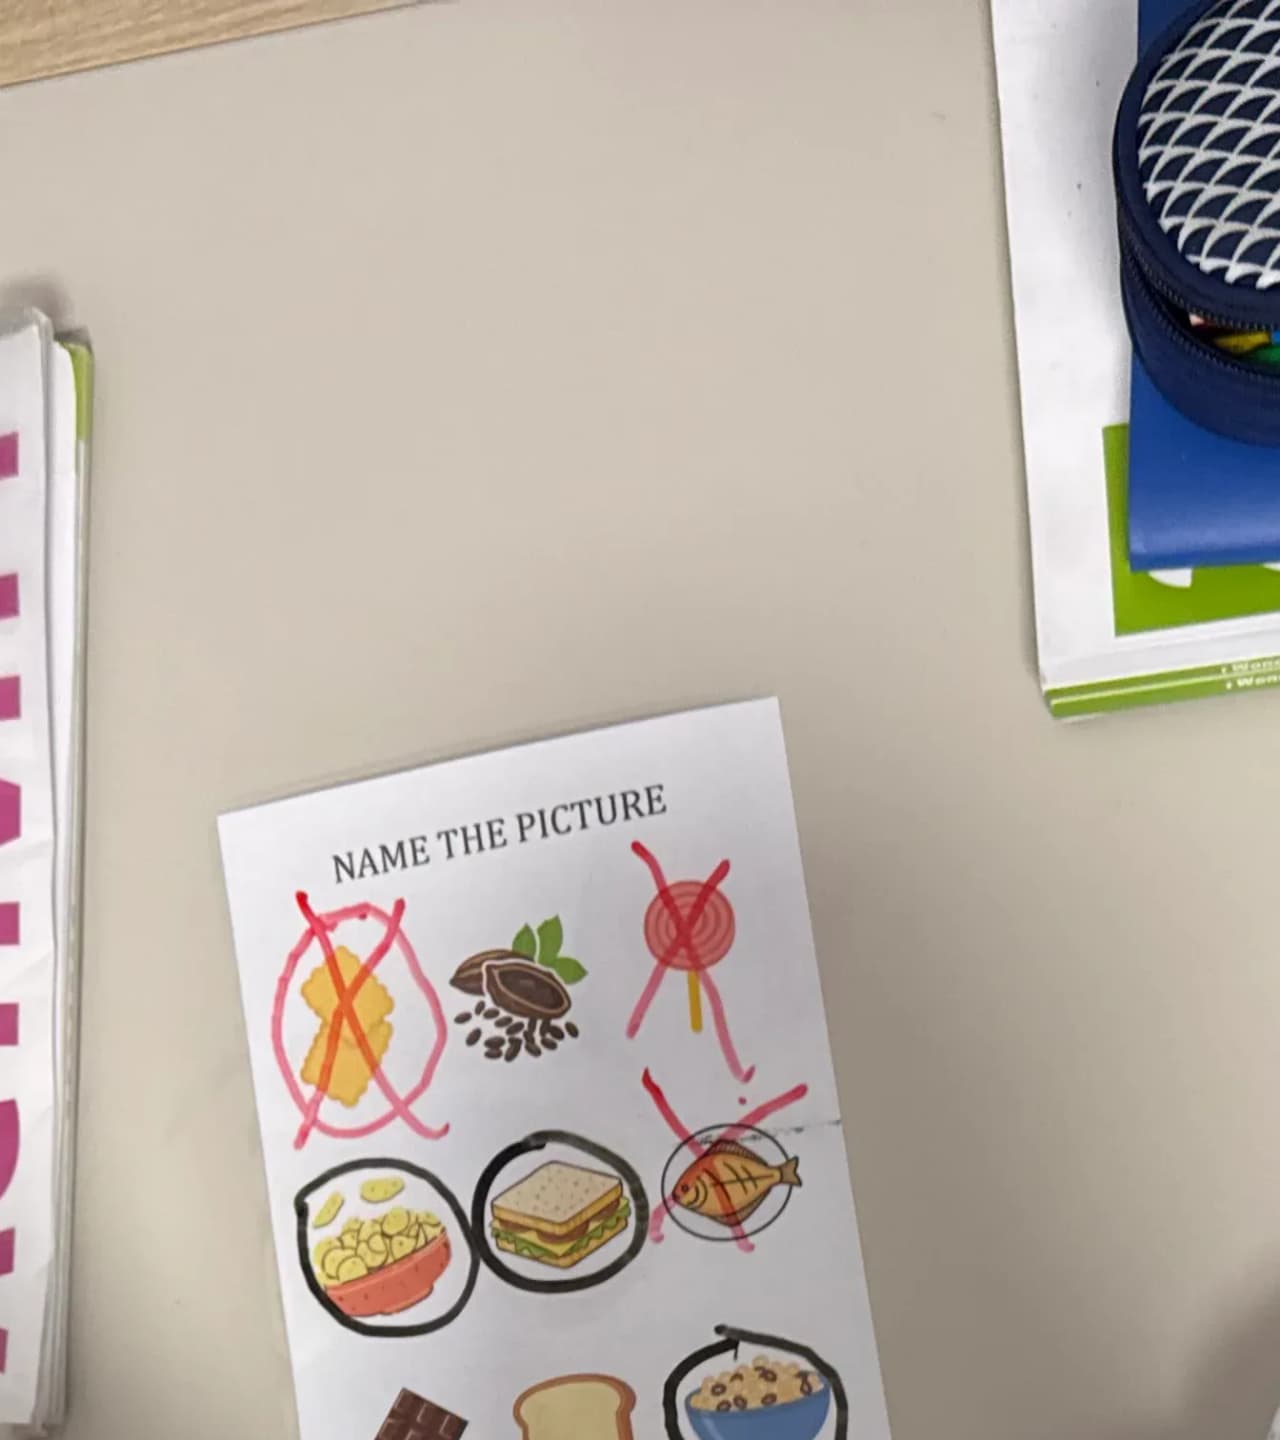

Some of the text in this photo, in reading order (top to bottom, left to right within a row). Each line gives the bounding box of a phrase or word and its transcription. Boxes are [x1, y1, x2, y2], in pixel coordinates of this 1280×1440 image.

[333, 783, 668, 884] NAME THE PICTURE
